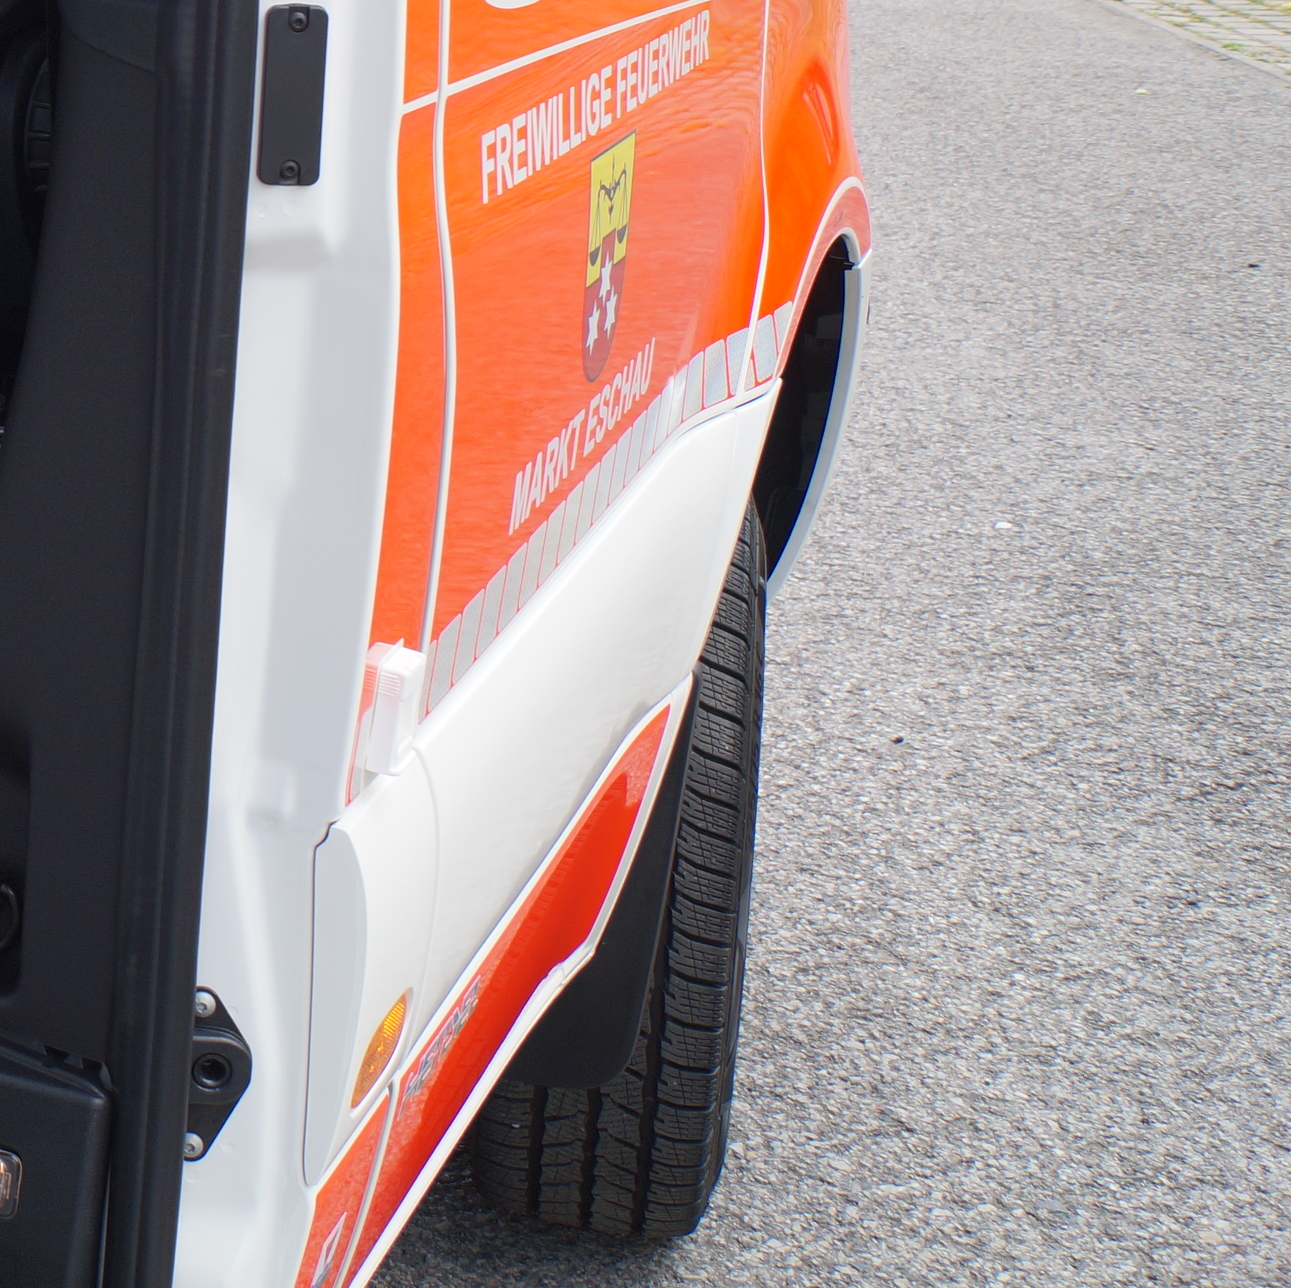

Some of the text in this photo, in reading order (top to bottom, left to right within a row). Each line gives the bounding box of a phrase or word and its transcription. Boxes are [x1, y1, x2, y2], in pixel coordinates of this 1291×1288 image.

[481, 10, 710, 205] FREIWILLIGE FEUERWEHR
[509, 337, 656, 536] MARKT ESCHAU
